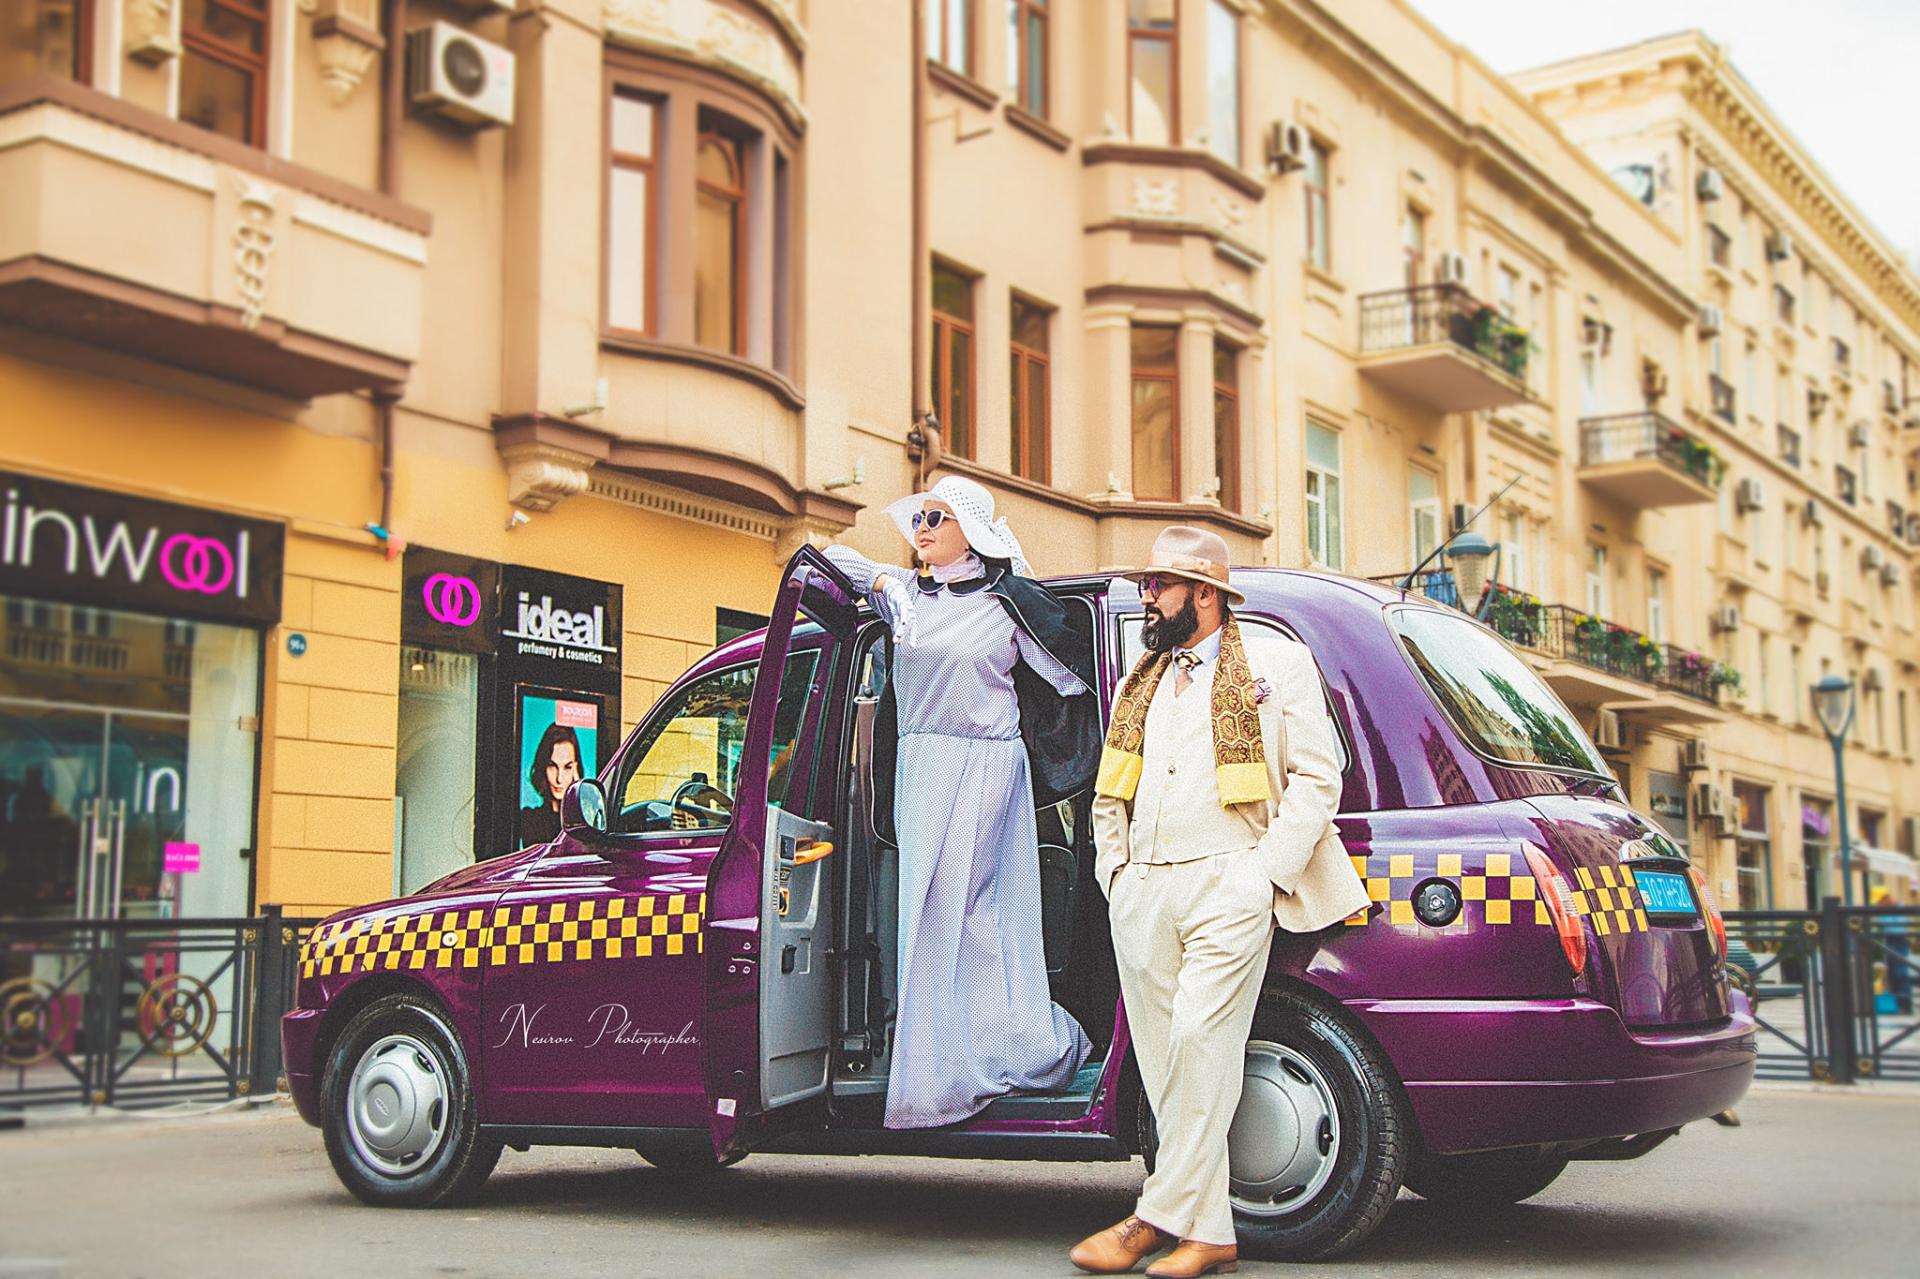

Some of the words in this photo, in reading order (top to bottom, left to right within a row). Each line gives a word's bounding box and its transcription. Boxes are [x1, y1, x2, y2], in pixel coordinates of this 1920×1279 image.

[3, 489, 249, 598] inwool
[517, 591, 604, 648] ideal
[518, 642, 557, 659] perfumery
[558, 647, 565, 658] &
[566, 649, 602, 664] cosmetics
